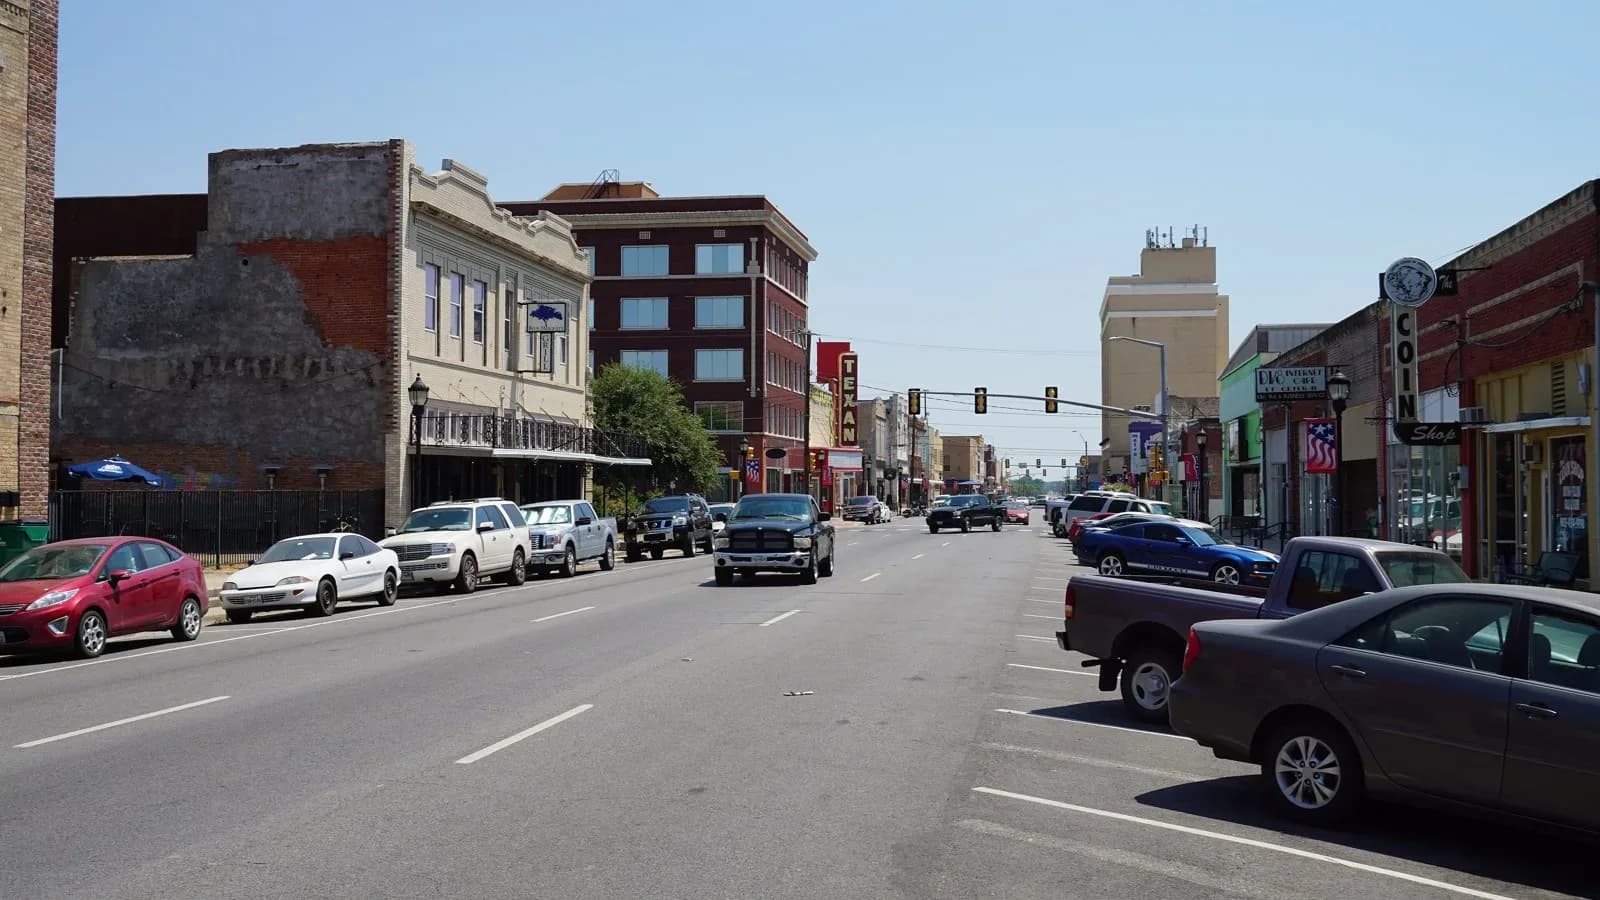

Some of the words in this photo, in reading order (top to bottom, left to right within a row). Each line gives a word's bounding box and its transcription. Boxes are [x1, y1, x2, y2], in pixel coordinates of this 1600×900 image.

[1438, 274, 1453, 289] The
[1285, 369, 1322, 377] INTERNET
[1397, 313, 1415, 418] COIN
[843, 359, 855, 442] TEXAN
[1410, 425, 1456, 443] Shop
